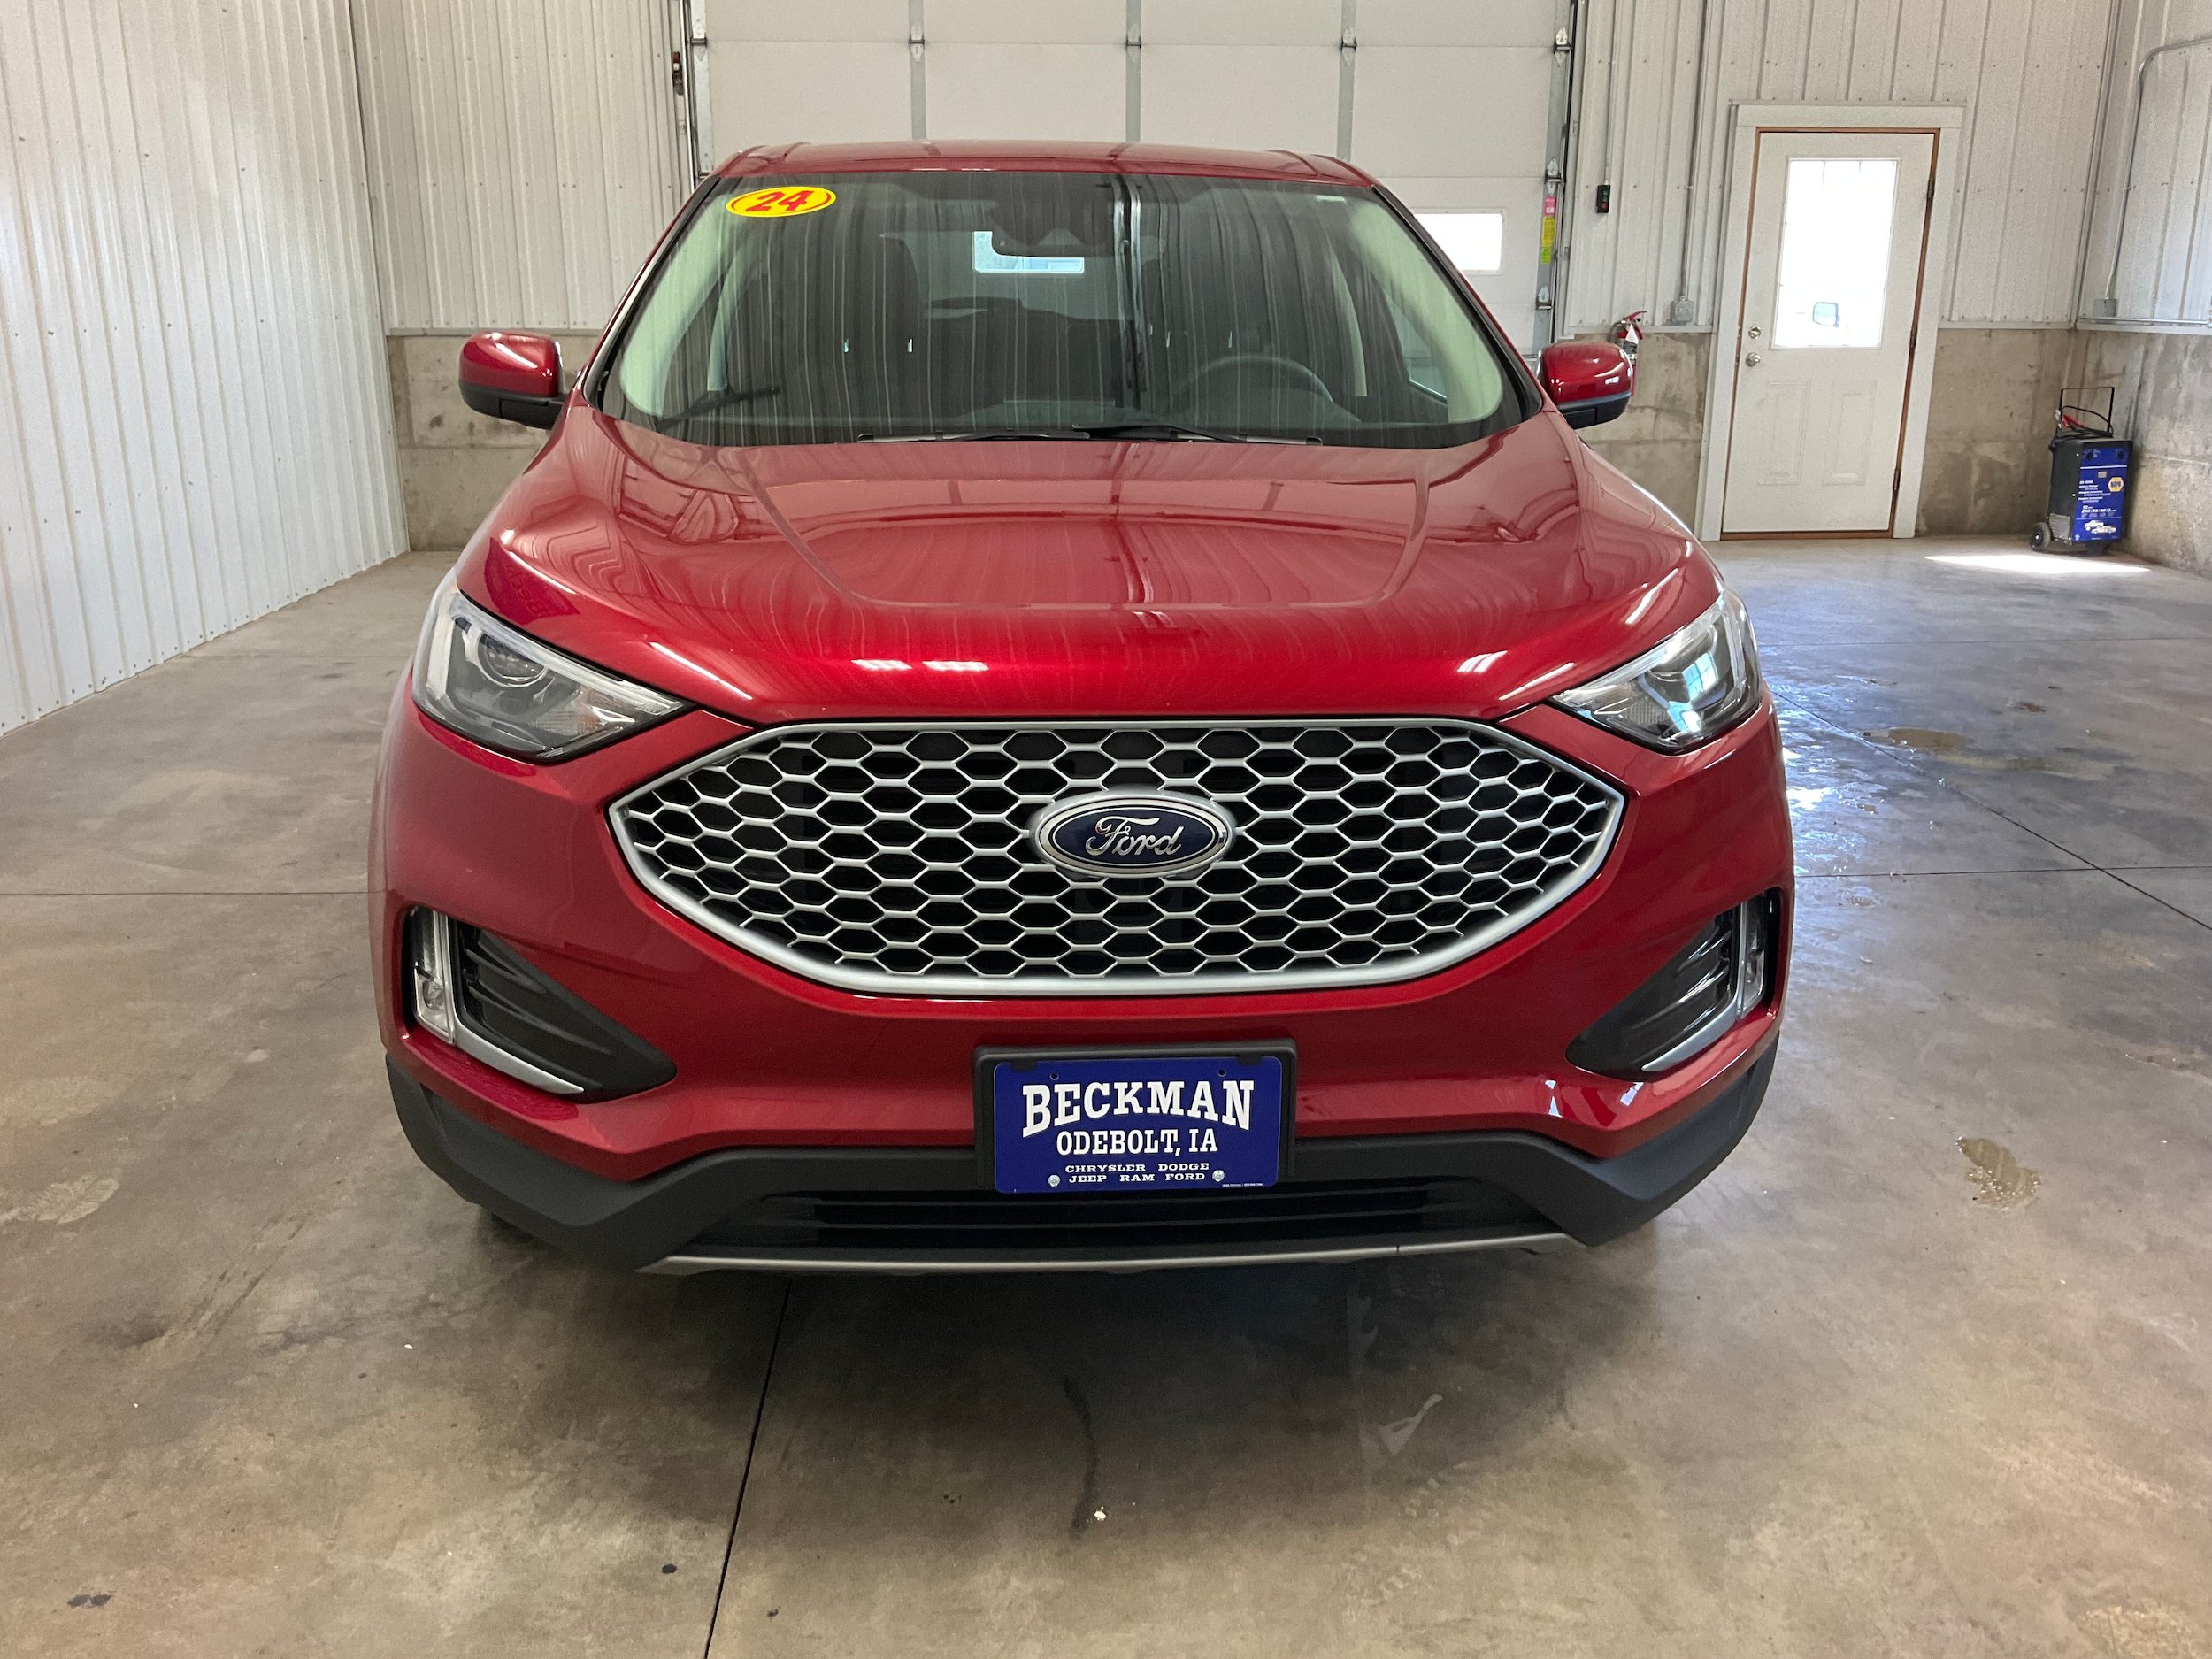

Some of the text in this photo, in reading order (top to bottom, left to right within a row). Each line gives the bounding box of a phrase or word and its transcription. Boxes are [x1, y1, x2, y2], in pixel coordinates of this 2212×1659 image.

[745, 190, 814, 212] 24
[1085, 815, 1185, 856] Ford
[1022, 1079, 1255, 1138] BECKMAN
[1056, 1128, 1218, 1156] ODEBOLT, IA
[1064, 1163, 1210, 1173] CHRYSLER DODGE
[1069, 1172, 1205, 1183] JEEP RAM FORD
